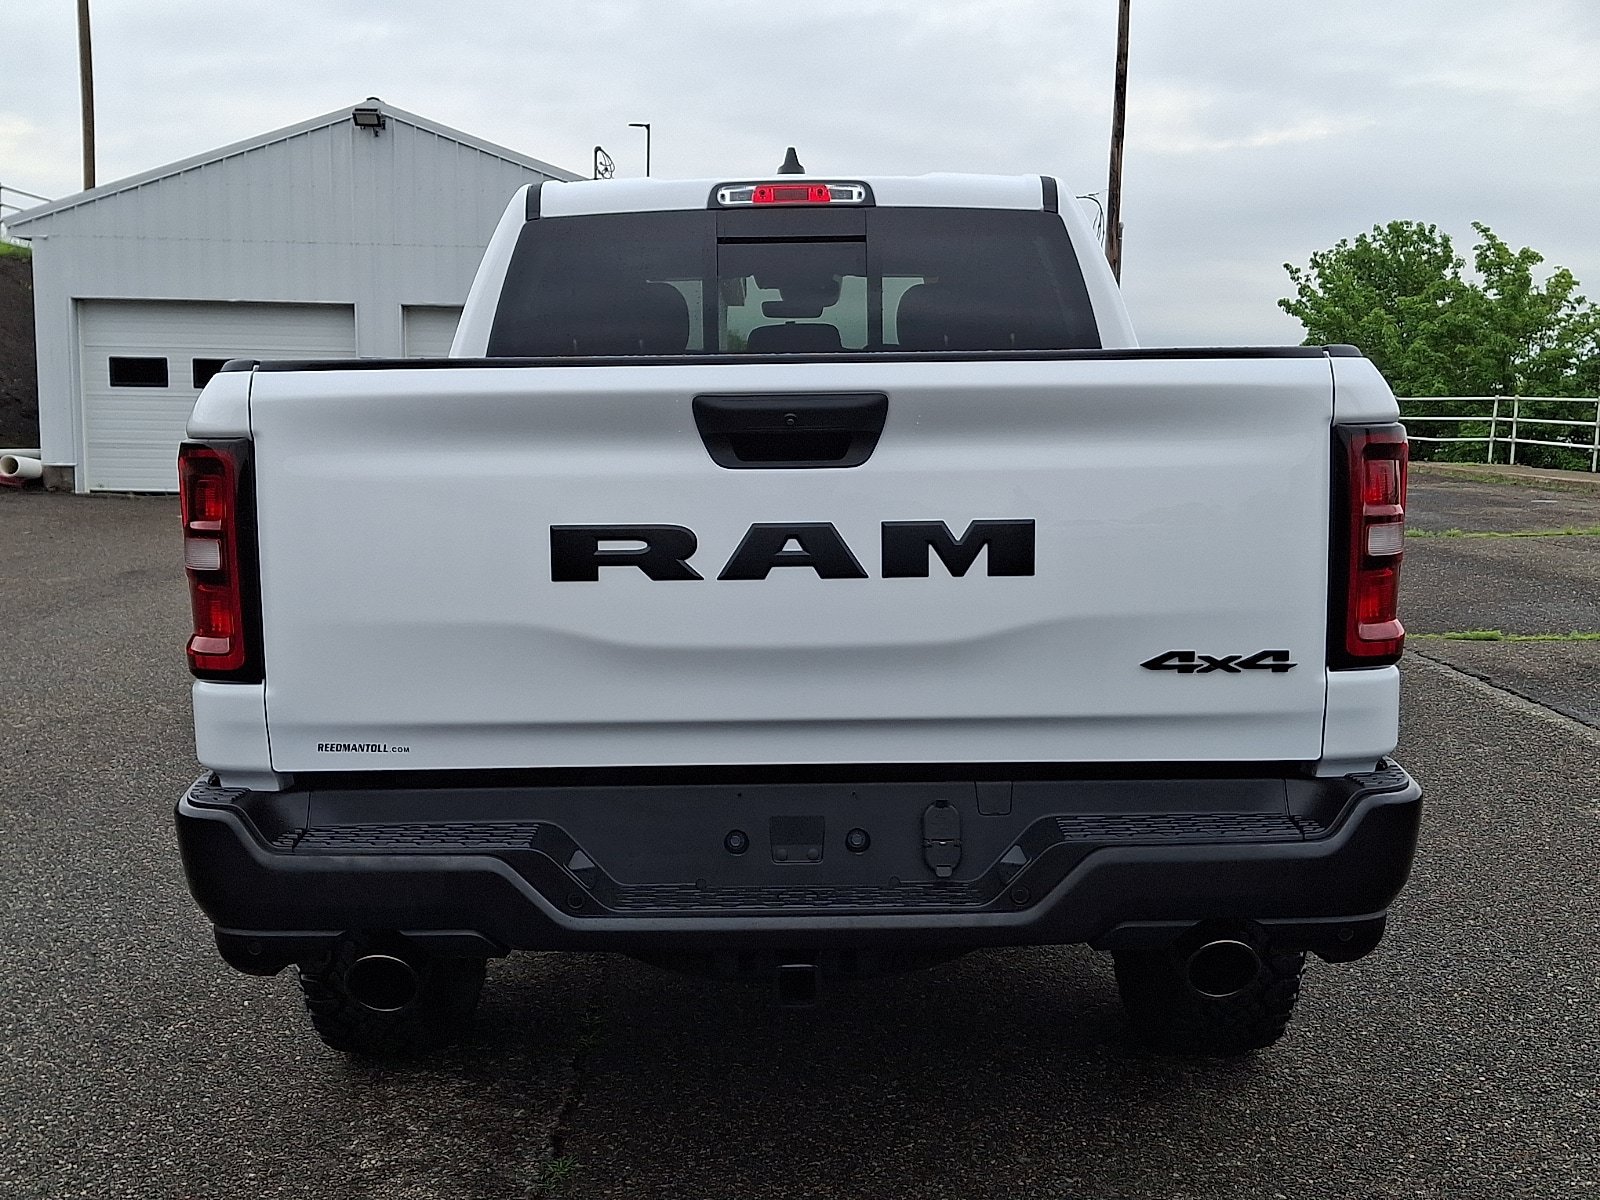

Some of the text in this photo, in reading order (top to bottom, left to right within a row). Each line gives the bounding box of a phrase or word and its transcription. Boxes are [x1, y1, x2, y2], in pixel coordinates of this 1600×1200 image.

[550, 519, 1035, 582] RAM
[1139, 650, 1298, 674] 4x4
[317, 743, 410, 753] REEDMANTOLL.COM
